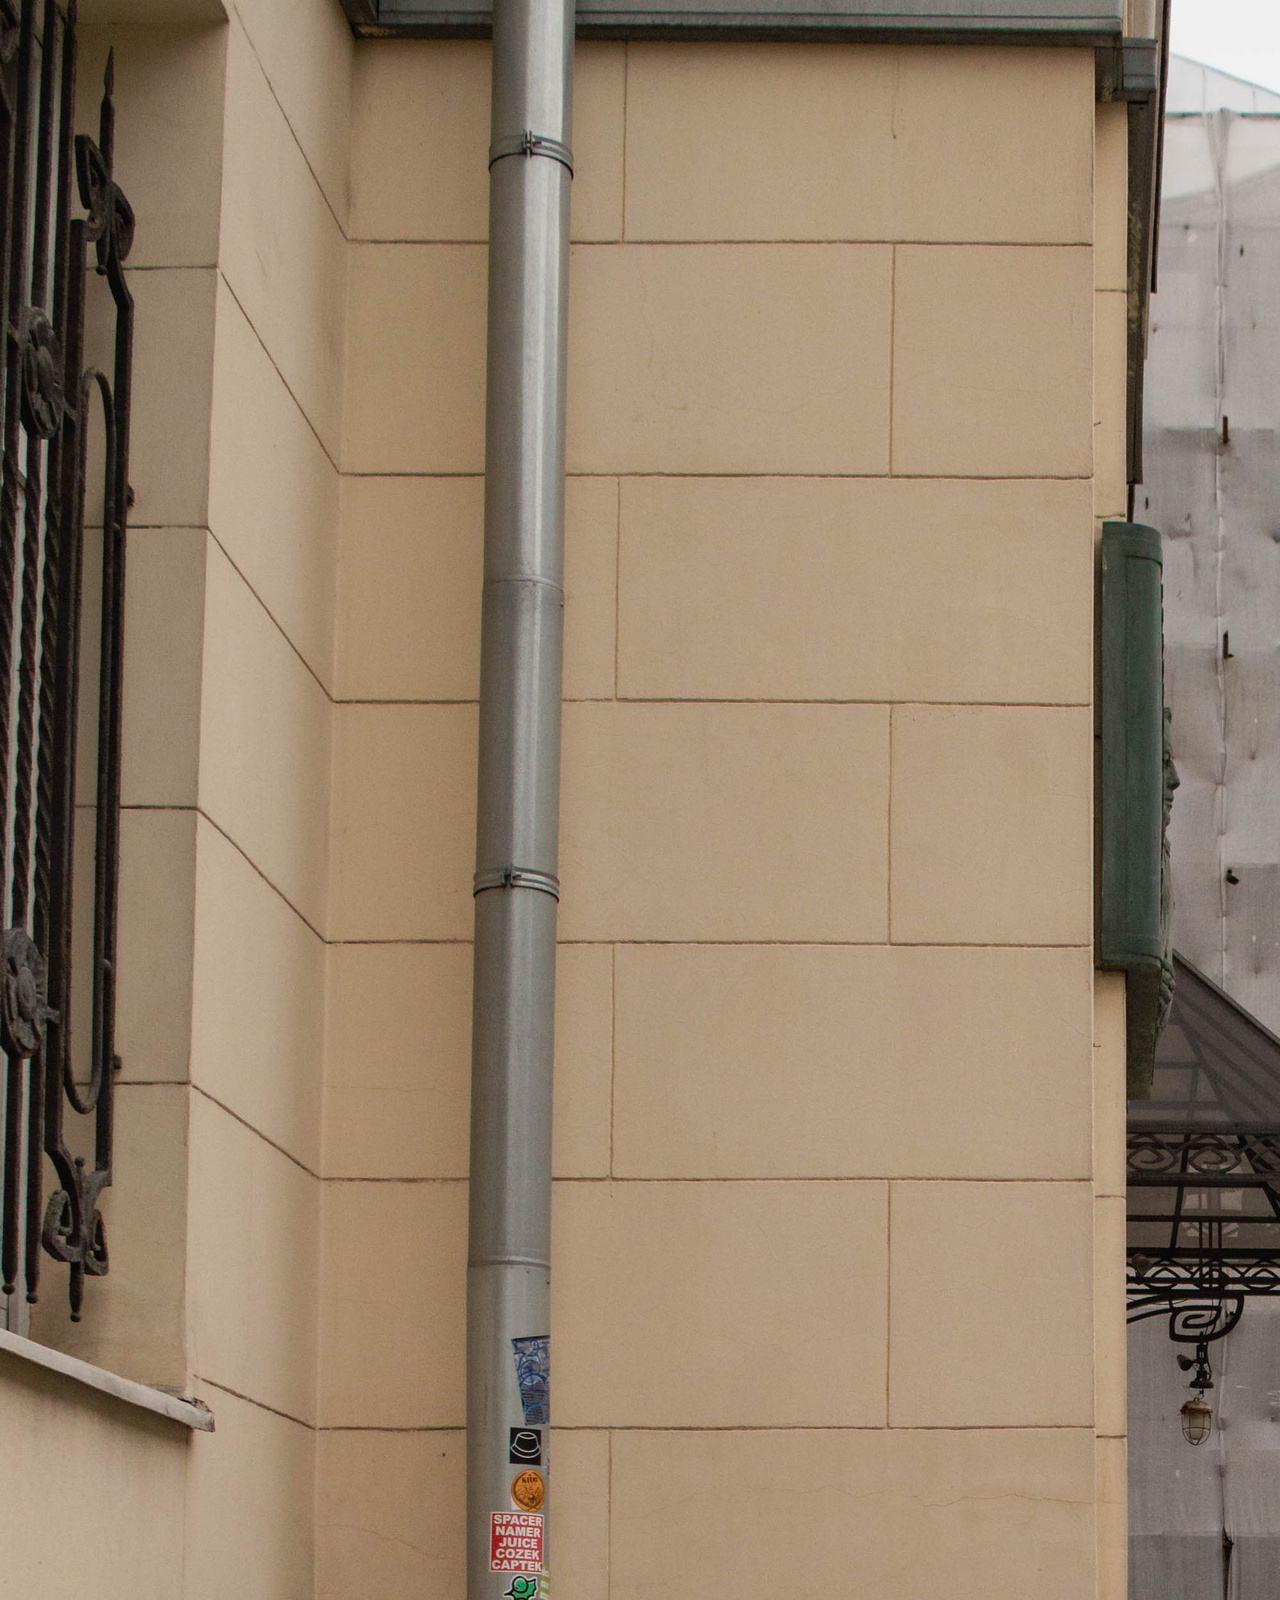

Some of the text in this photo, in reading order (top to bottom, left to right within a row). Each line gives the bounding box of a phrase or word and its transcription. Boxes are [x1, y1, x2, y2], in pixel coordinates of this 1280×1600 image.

[493, 1514, 542, 1527] SPACER
[495, 1525, 541, 1538] NAMER
[498, 1537, 538, 1549] JUICE
[495, 1548, 540, 1560] COZEK
[491, 1559, 542, 1572] CAPTEK
